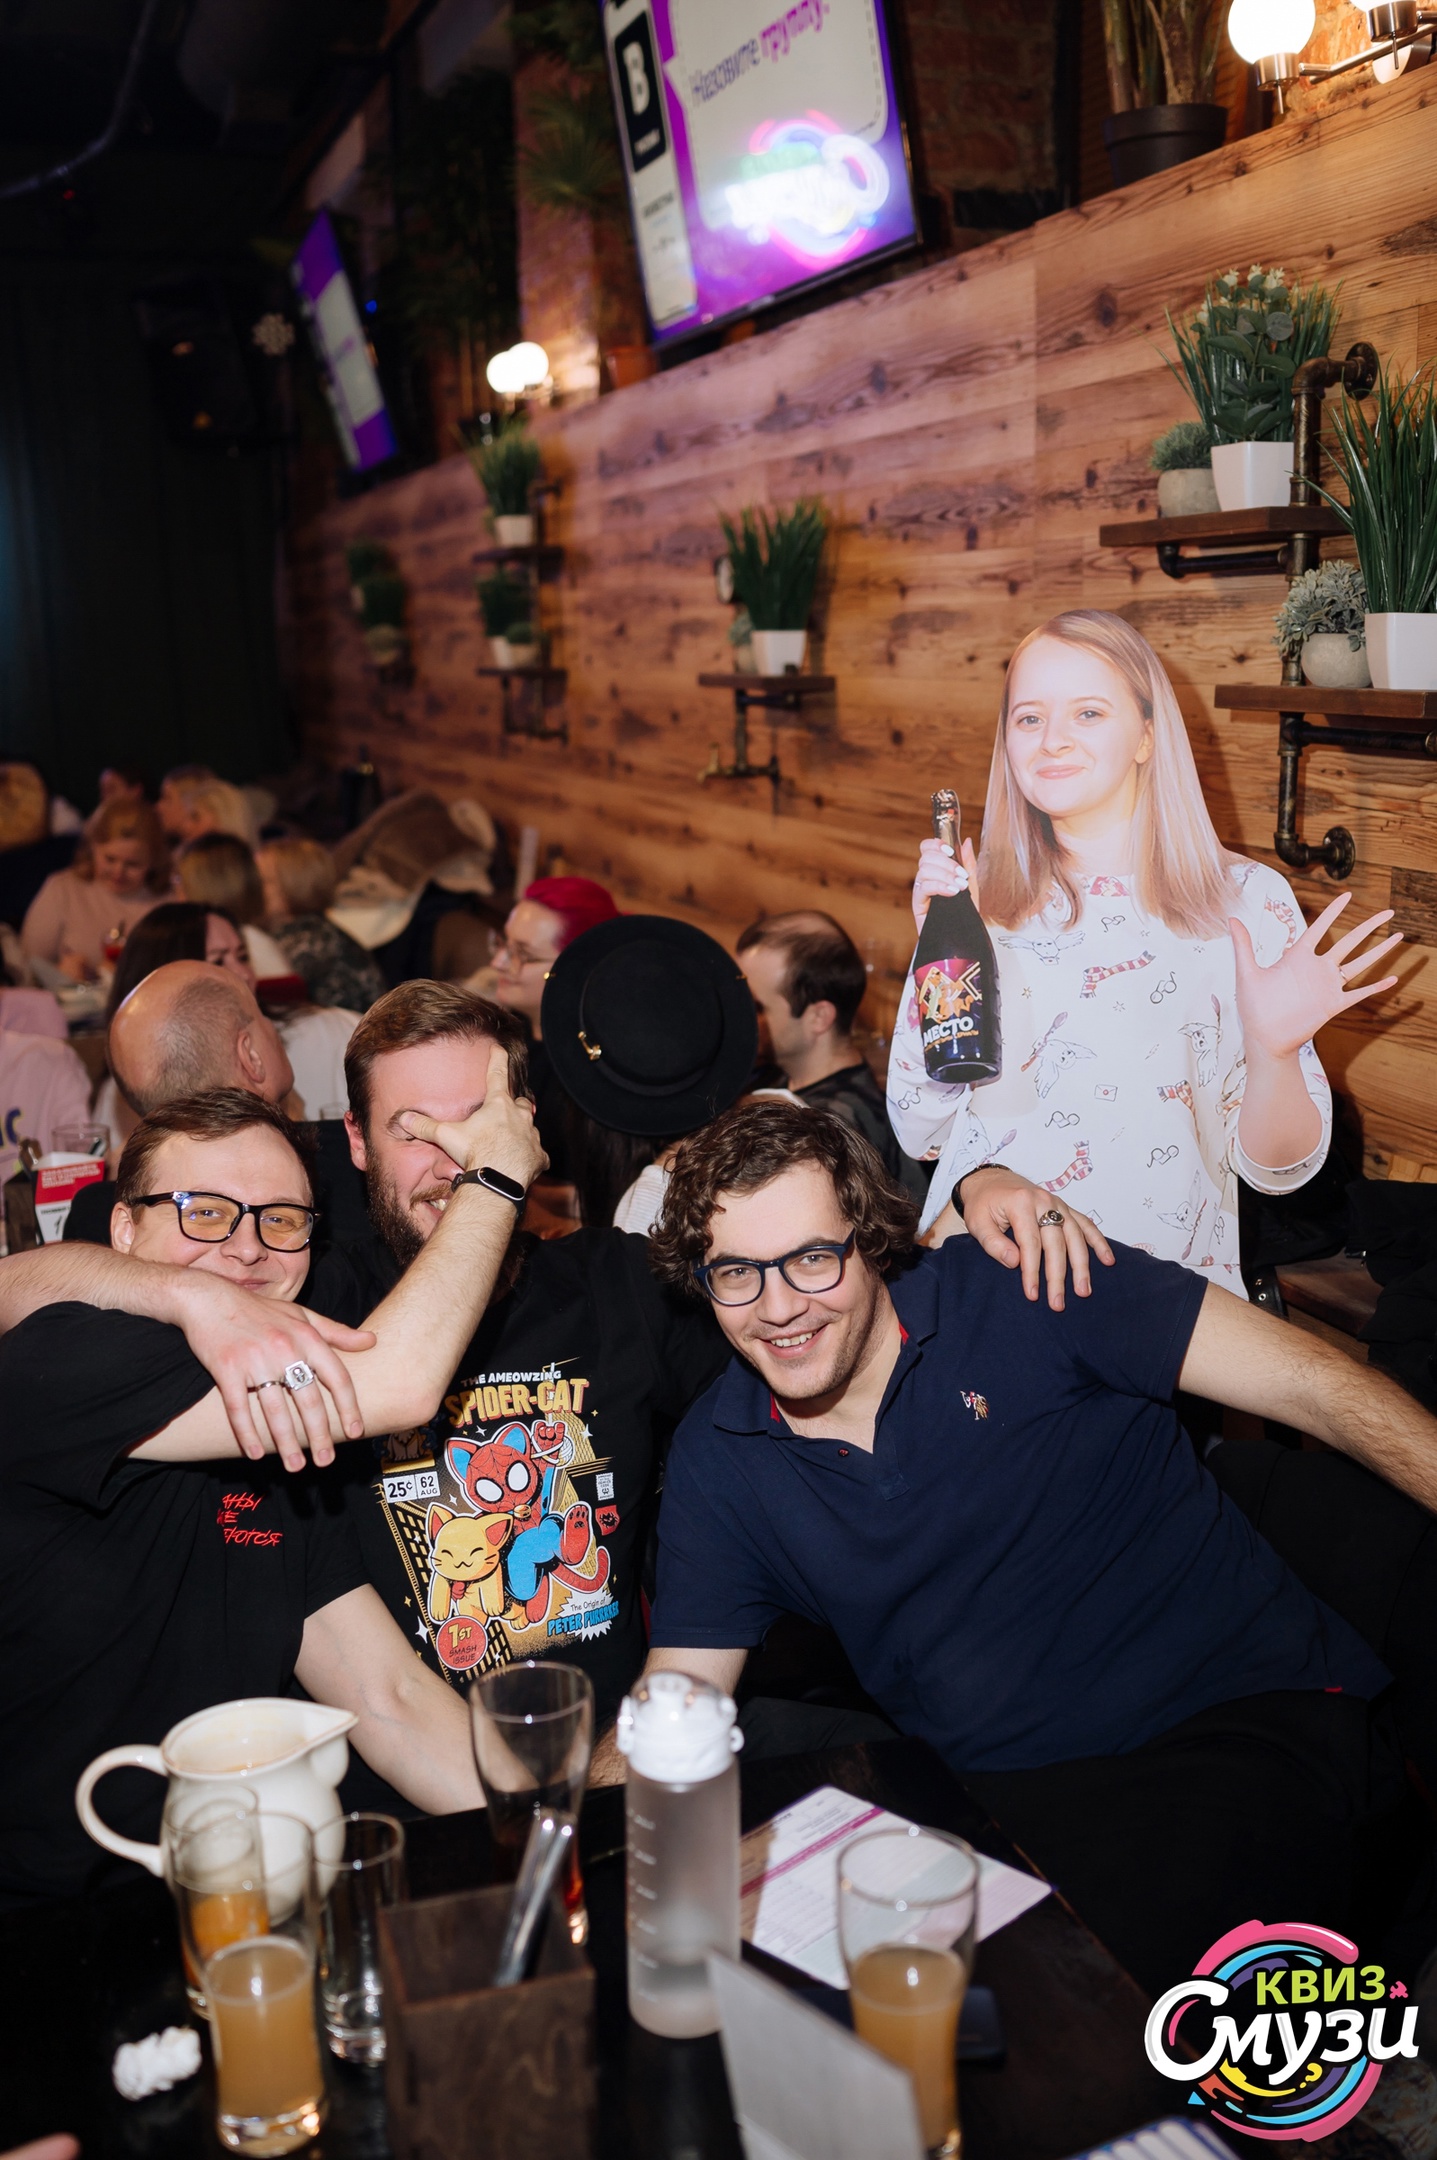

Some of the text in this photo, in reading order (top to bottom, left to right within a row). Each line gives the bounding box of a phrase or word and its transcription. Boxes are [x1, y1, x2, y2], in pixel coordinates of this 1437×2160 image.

[922, 1015, 974, 1047] МЕСТО
[461, 1370, 562, 1387] THE AMEOWZING
[444, 1378, 590, 1428] SPIDER-CAT
[420, 1475, 434, 1488] 62
[420, 1488, 438, 1496] AUG
[571, 1603, 582, 1612] The
[583, 1598, 600, 1610] Origin
[547, 1612, 583, 1638] PETER
[448, 1623, 473, 1649] 1ST
[449, 1645, 477, 1658] SMASH
[453, 1653, 476, 1665] ISSUE
